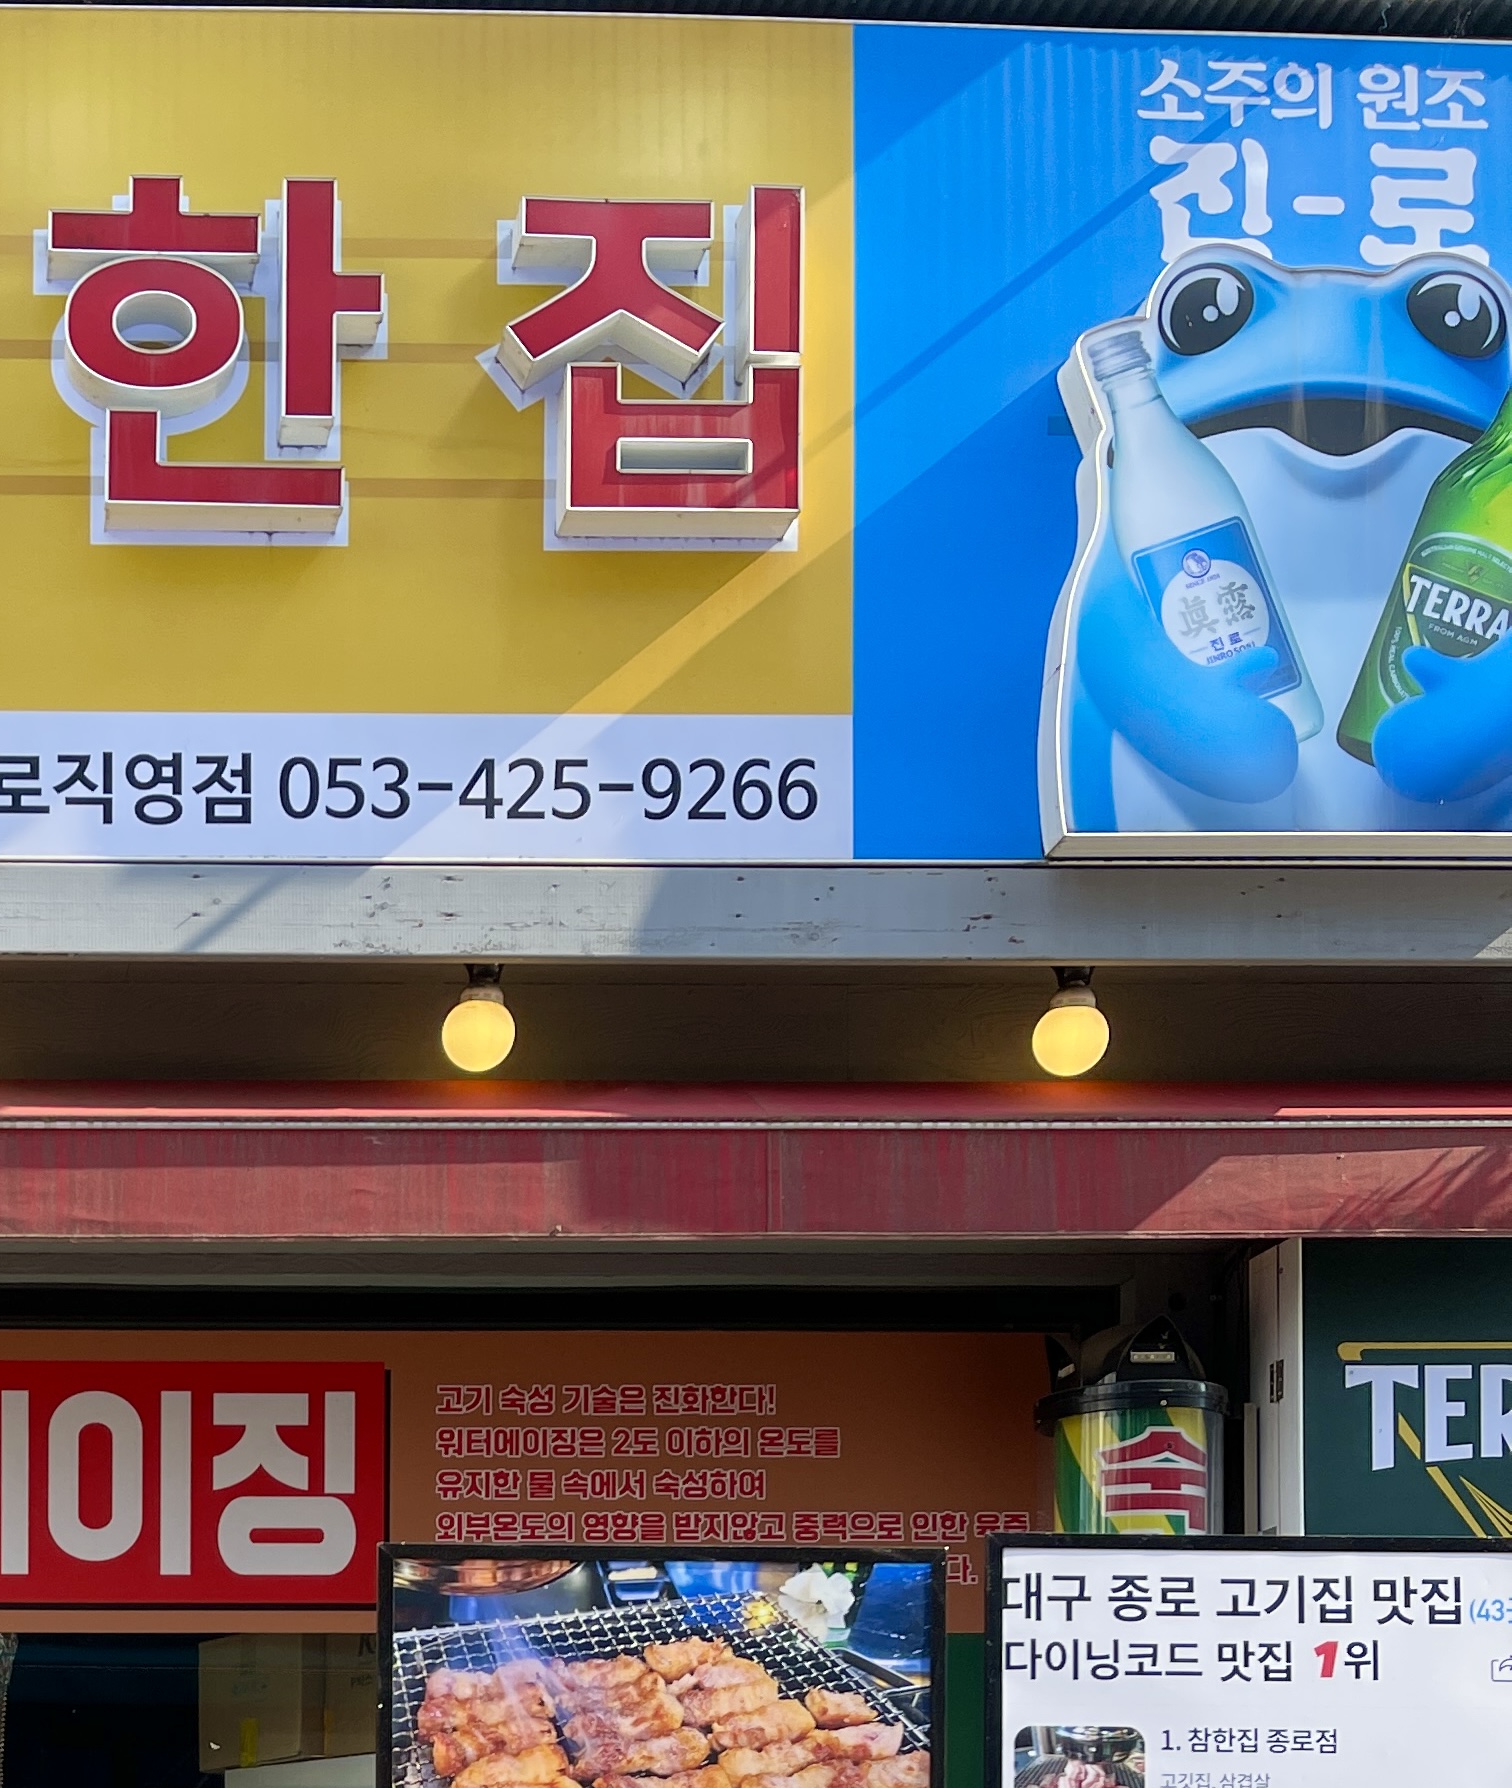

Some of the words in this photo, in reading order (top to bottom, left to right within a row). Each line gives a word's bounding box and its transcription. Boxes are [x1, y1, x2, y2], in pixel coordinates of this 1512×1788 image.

[1138, 58, 1333, 129] 소주의
[1356, 64, 1489, 131] 원조
[1149, 134, 1490, 267] 진-로
[1406, 574, 1512, 640] TERRA
[1428, 623, 1454, 638] FROM
[1458, 634, 1478, 646] AGM
[278, 756, 820, 822] 053-425-9266
[435, 1384, 493, 1416] 고기
[500, 1384, 557, 1416] 숙성
[562, 1384, 646, 1416] 기술은
[652, 1384, 777, 1416] 진화한다!
[435, 1426, 606, 1460] 워터에이징은
[612, 1426, 660, 1460] 2도
[665, 1426, 750, 1460] 이하의
[758, 1426, 842, 1460] 온도를
[435, 1468, 522, 1501] 유지한
[527, 1468, 557, 1501] 물
[562, 1468, 647, 1501] 속에서
[652, 1468, 767, 1501] 숙성하여
[435, 1510, 575, 1543] 외부온도의
[583, 1510, 667, 1543] 영향을
[674, 1511, 786, 1543] 받지않고
[792, 1511, 905, 1542] 중력으로
[911, 1511, 969, 1542] 인한
[1002, 1571, 1091, 1621] 대구
[1107, 1573, 1200, 1622] 종로
[1216, 1575, 1352, 1624] 고기집
[1373, 1576, 1463, 1625] 맛집
[1004, 1638, 1203, 1680] 다이닝코드
[1216, 1640, 1293, 1682] 맛집
[1313, 1640, 1380, 1681] 1위
[1187, 1728, 1259, 1754] 참한집
[1267, 1729, 1339, 1755] 종로점
